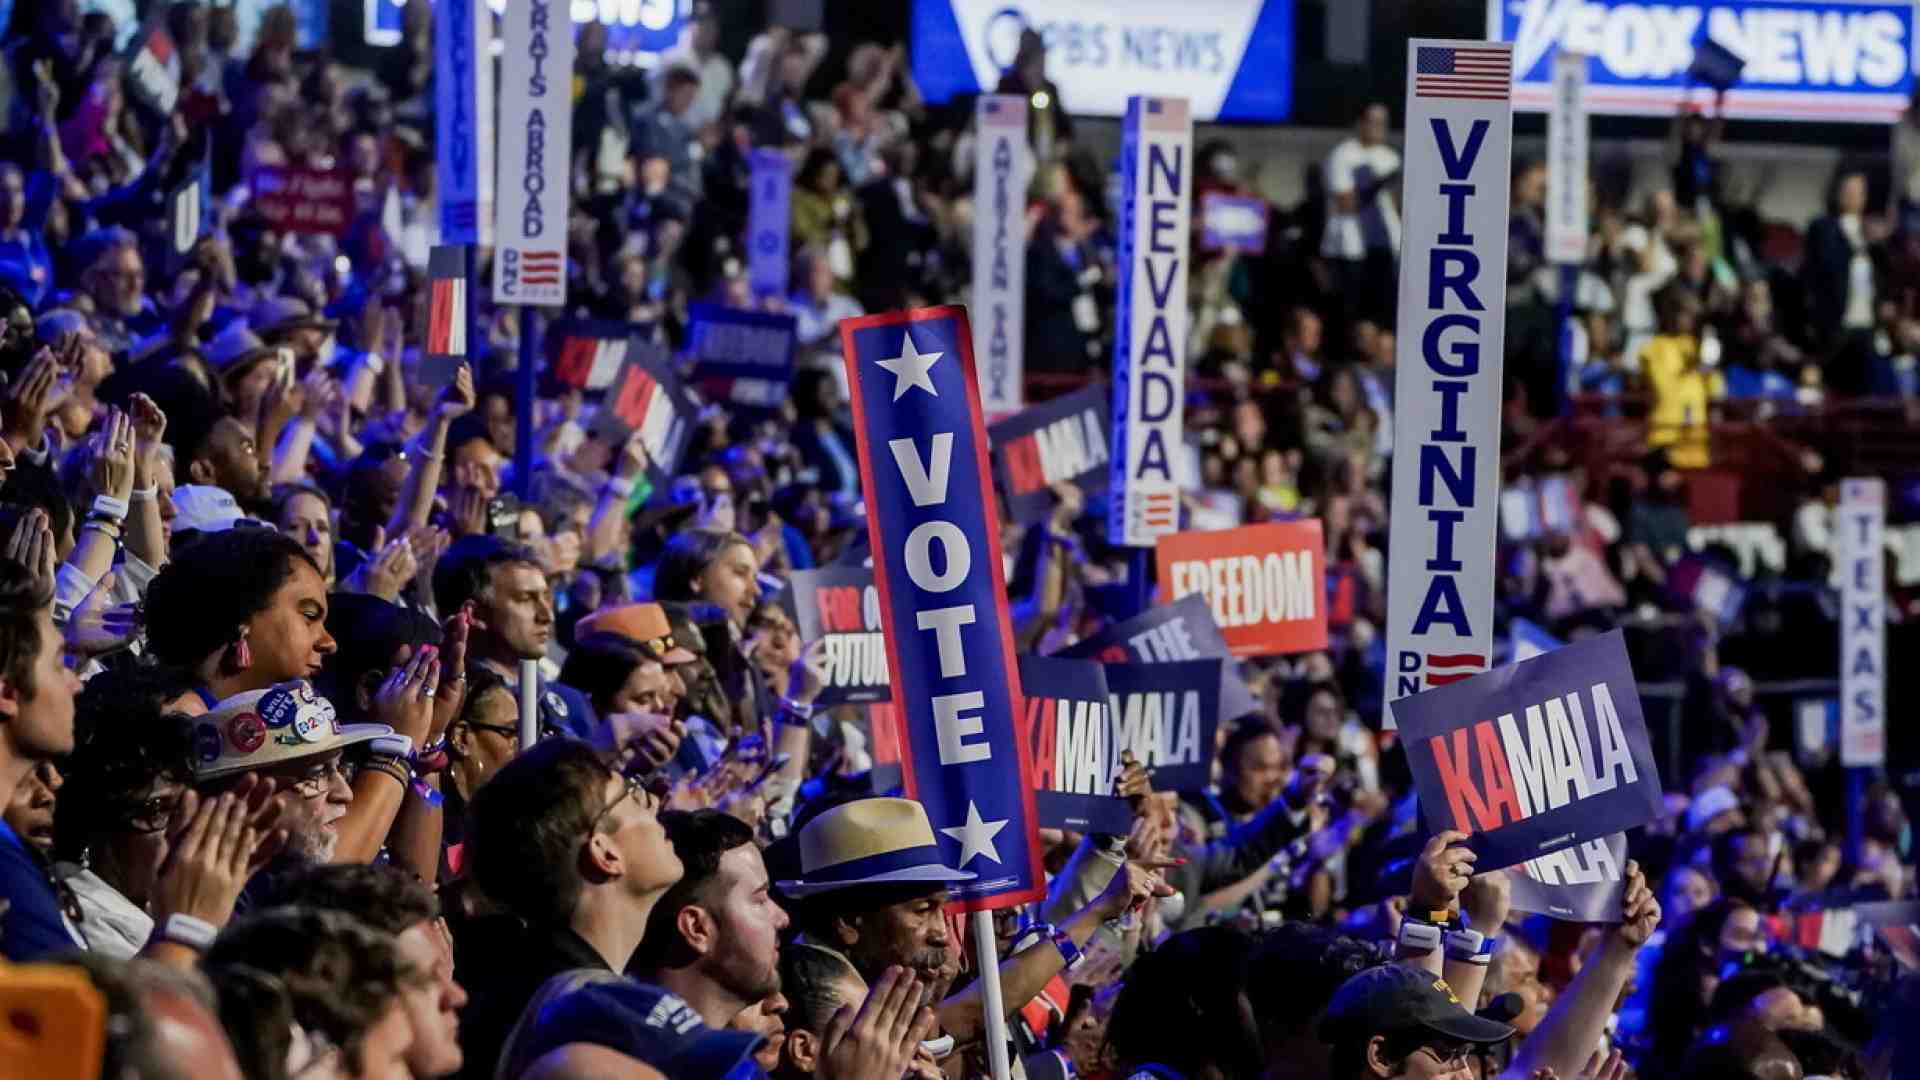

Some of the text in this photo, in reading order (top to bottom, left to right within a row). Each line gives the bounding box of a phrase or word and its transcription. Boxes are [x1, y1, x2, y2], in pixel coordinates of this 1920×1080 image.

[1119, 25, 1223, 76] NEWS
[1563, 2, 1701, 79] FOX
[522, 108, 546, 238] ABROAD
[1136, 144, 1182, 481] NEVADA
[1411, 118, 1491, 637] VIRGINIA
[888, 432, 992, 766] VOTE
[1171, 549, 1316, 630] FREEDOM
[1853, 515, 1876, 722] TEXAS
[1128, 617, 1200, 664] THE
[1399, 651, 1422, 697] DN
[269, 695, 294, 723] VOTE
[1109, 691, 1199, 768] MALA
[1430, 682, 1639, 837] KAMALA
